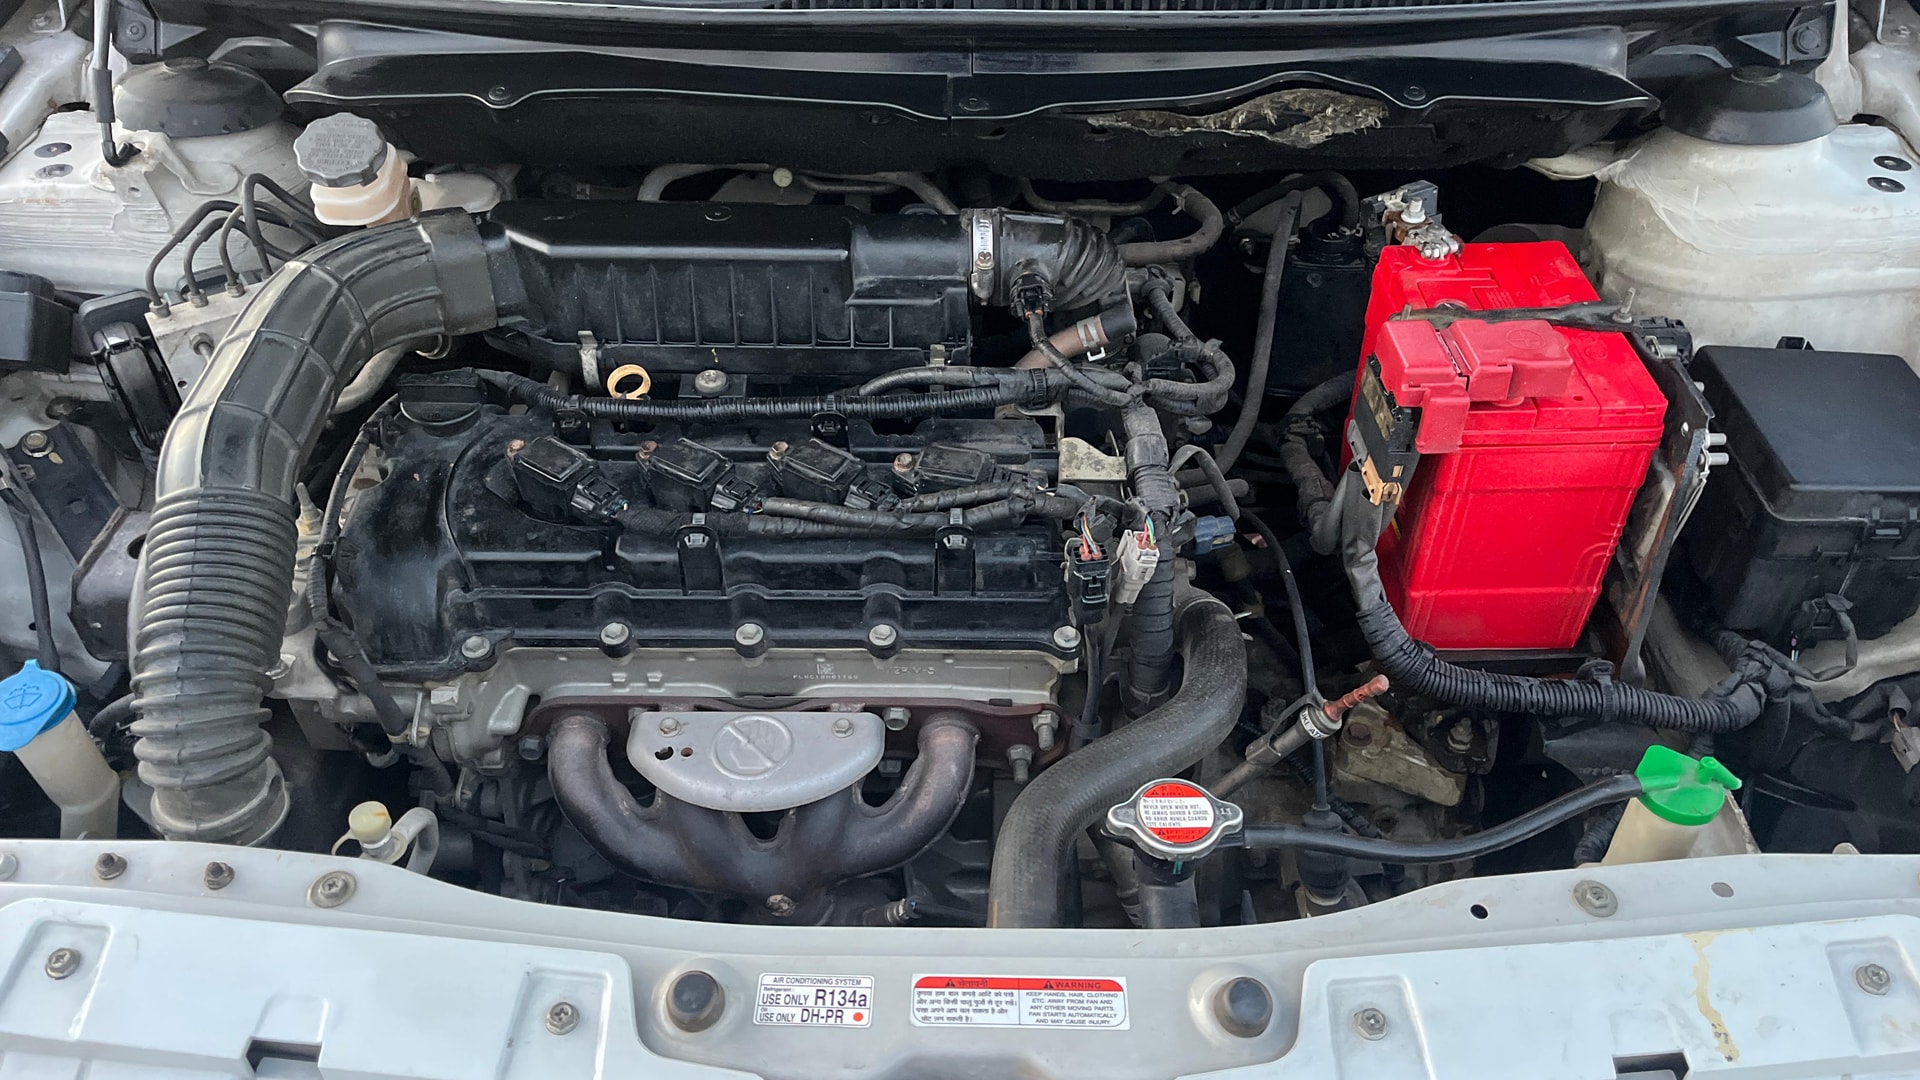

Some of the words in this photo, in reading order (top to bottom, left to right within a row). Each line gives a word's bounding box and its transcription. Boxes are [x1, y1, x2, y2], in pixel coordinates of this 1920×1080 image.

[786, 977, 833, 985] CONDITIONING
[762, 994, 781, 1005] USE
[784, 994, 809, 1005] ONLY
[814, 989, 867, 1007] R134a
[759, 1013, 774, 1022] USE
[776, 1013, 795, 1022] ONLY
[800, 1009, 844, 1023] DH-PR
